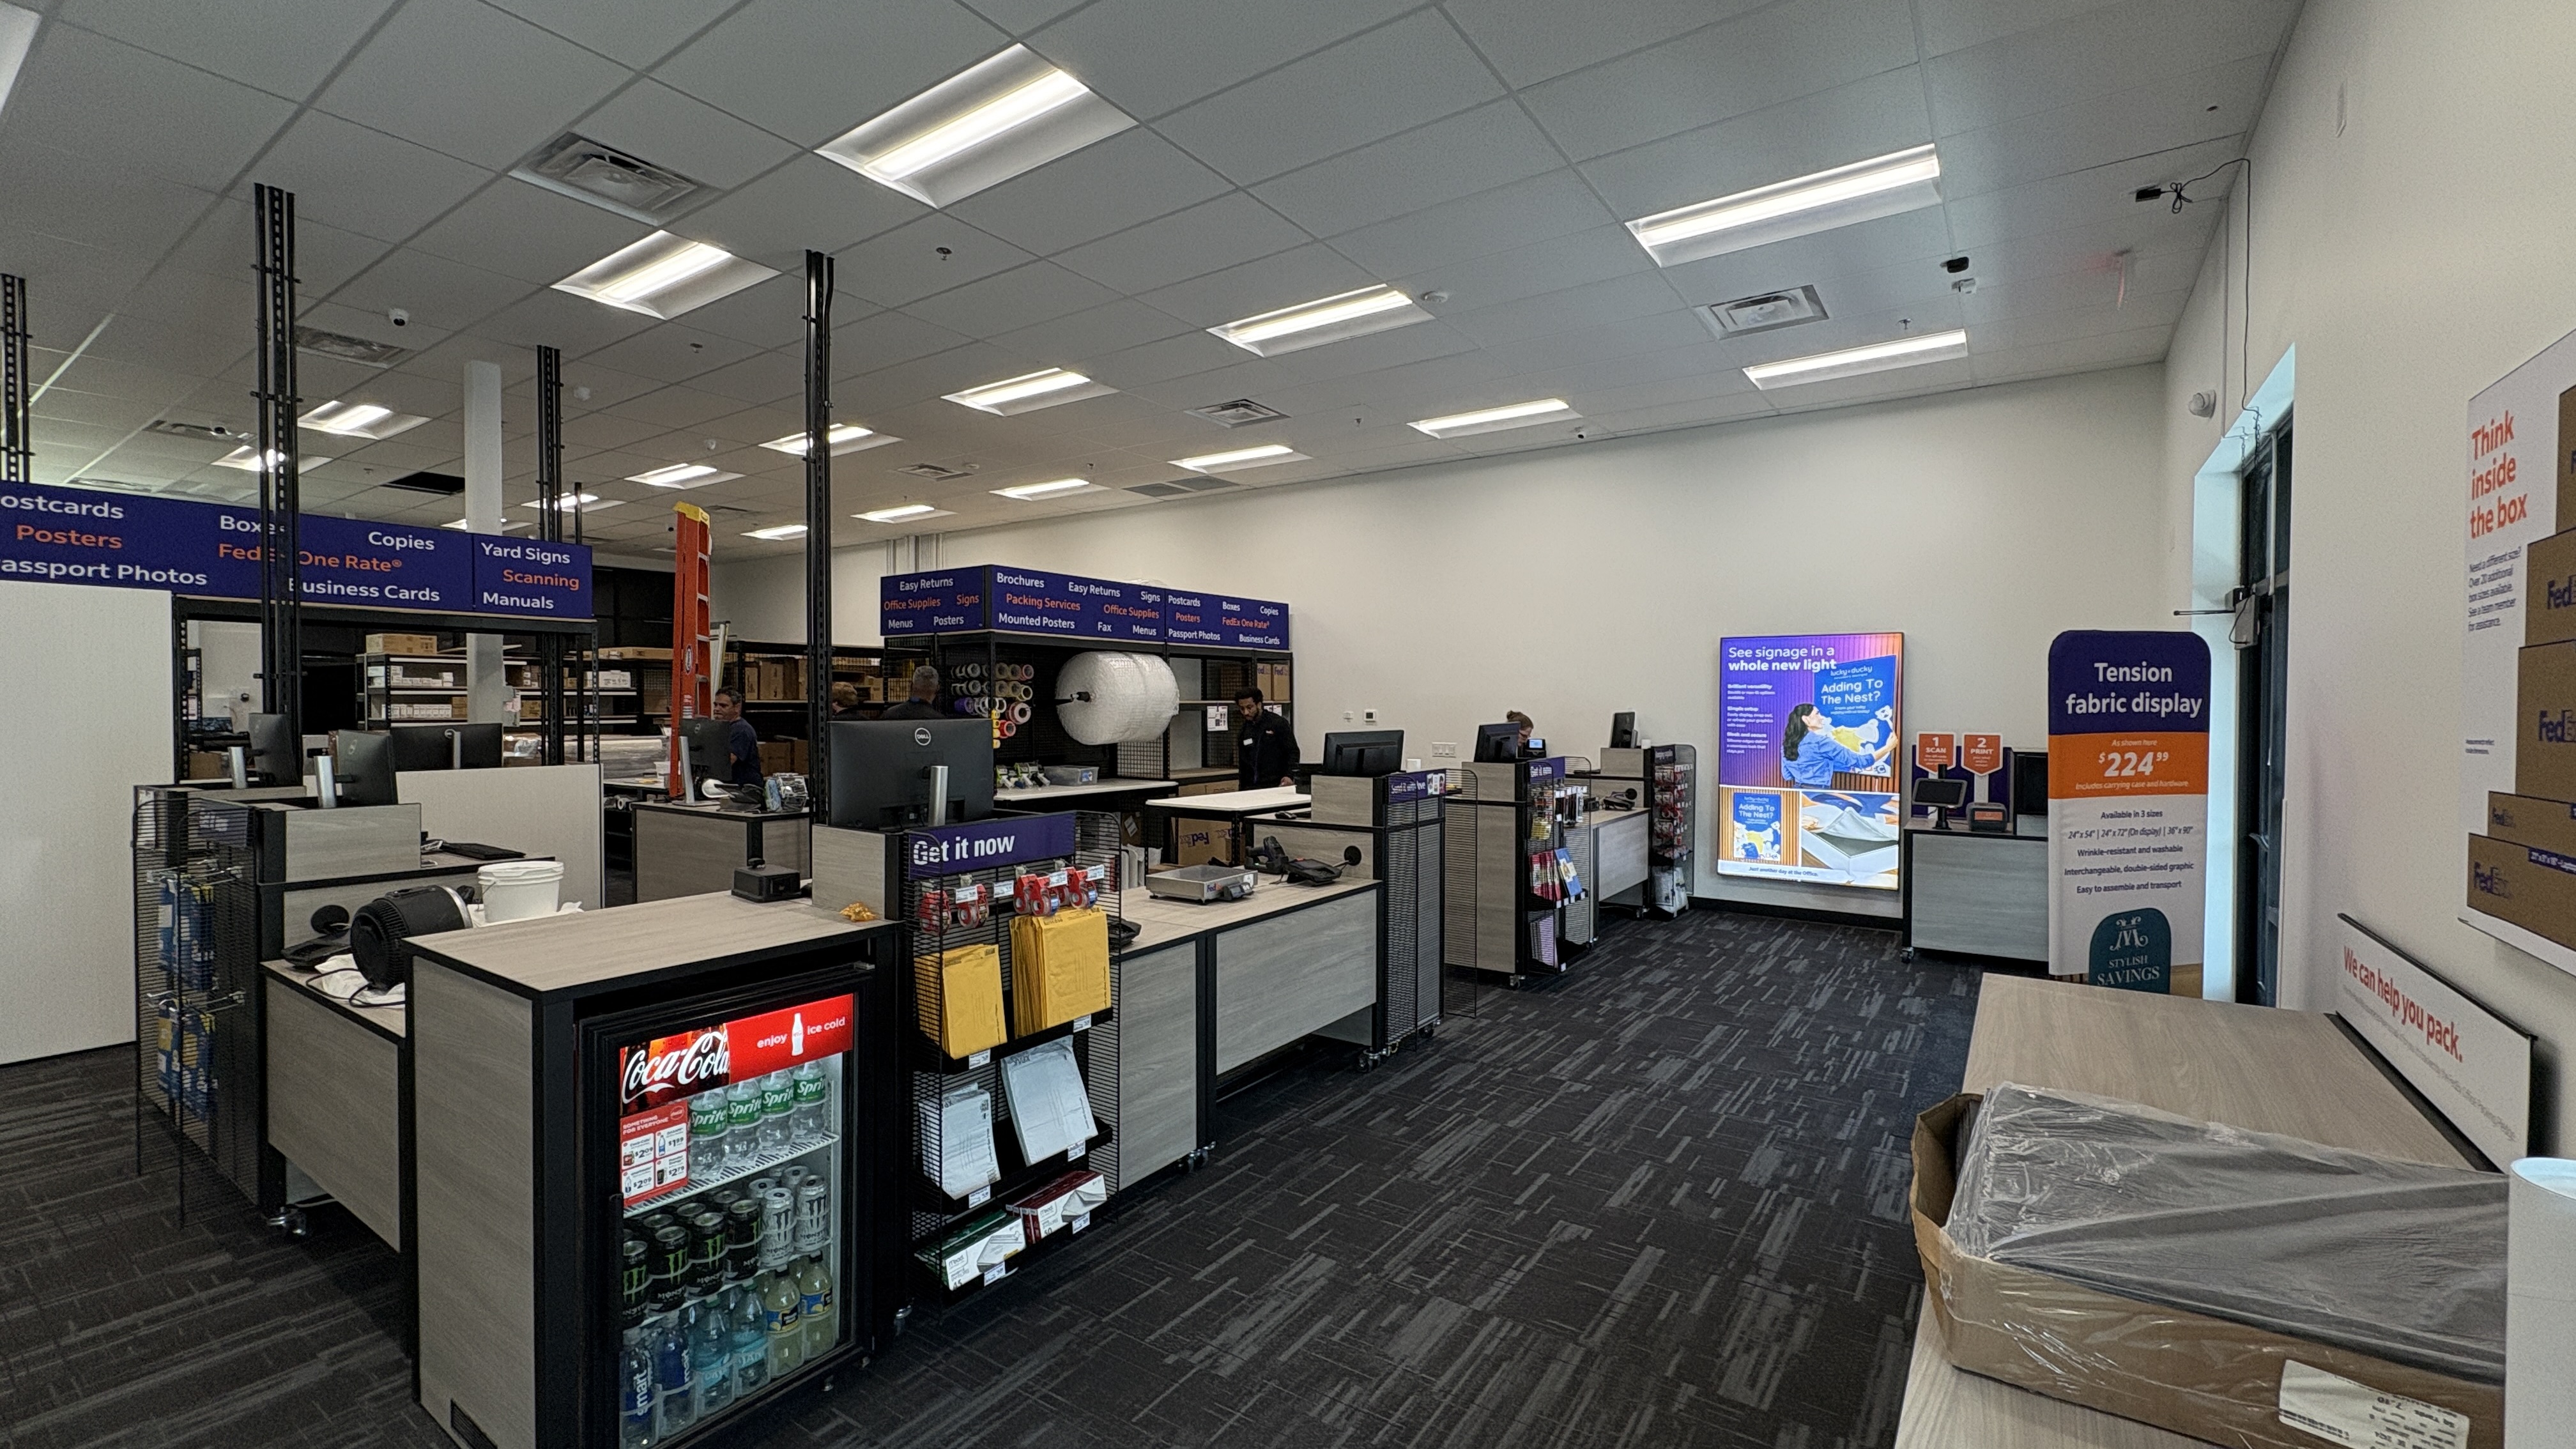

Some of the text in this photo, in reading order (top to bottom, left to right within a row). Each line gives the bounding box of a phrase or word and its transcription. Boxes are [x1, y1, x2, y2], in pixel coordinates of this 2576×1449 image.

[2472, 410, 2514, 461] Think
[2472, 452, 2516, 501] inside
[0, 494, 124, 519] ostcards
[2471, 493, 2527, 539] the box
[16, 524, 123, 549] Posters
[368, 532, 435, 551] Copies
[481, 542, 571, 565] Yard Signs
[345, 555, 402, 572] Rate®
[0, 558, 208, 585] assport Photos
[503, 569, 579, 591] Scanning
[900, 577, 954, 592] Easy Returns
[997, 572, 1045, 588] Brochures
[385, 585, 440, 602] Cards
[1068, 581, 1121, 597] Easy Returns
[482, 592, 554, 610] Manuals
[884, 597, 941, 611] Office Supplies
[956, 594, 979, 607] Signs
[1006, 593, 1080, 611] Packing Services
[1140, 592, 1161, 604] Signs
[1168, 595, 1201, 607] Postcards
[1103, 604, 1160, 620] Office Supplies
[1222, 601, 1240, 611] Boxes
[1260, 606, 1279, 616] Copies
[888, 618, 913, 629] Menus
[933, 615, 964, 626] Posters
[998, 612, 1075, 629] Mounted Posters
[1176, 612, 1200, 623] Posters
[1222, 617, 1240, 627] FedEx
[1241, 618, 1253, 627] One
[1098, 622, 1112, 632] Fax
[1132, 625, 1156, 636] Menus
[1168, 629, 1221, 641] Passport Photos
[1239, 634, 1280, 645] Business Cards
[1728, 645, 1835, 660] See signage in a
[1728, 658, 1837, 673] whole new light
[2094, 661, 2173, 682] Tension
[1821, 678, 1883, 694] Adding To
[1821, 691, 1881, 705] The Nest?
[2066, 691, 2202, 718] fabric display
[1932, 737, 1939, 747] 1
[1977, 738, 1987, 747] 2
[2103, 781, 2130, 790] carrying
[1738, 803, 1775, 813] Adding To
[1753, 811, 1774, 819] Nest?
[2101, 810, 2132, 820] Available
[1180, 832, 1210, 847] FedEx
[913, 835, 1015, 866] Get it now
[2077, 847, 2137, 857] Wrinkle-resistant
[2152, 845, 2183, 853] washable
[2064, 862, 2194, 876] Interchangeable, double-sided graphic
[2076, 885, 2093, 894] Easy
[2103, 883, 2135, 892] assemble
[2150, 880, 2182, 889] transport
[2108, 954, 2147, 969] STYLISH
[2097, 966, 2159, 986] SAVINGS
[2343, 946, 2463, 1063] We can help you pack.
[756, 1016, 846, 1050] enjoy ice cold
[622, 1031, 729, 1104] Coca-Cola
[623, 1115, 658, 1129] SOMETHING
[623, 1117, 669, 1135] FOR EVERYONE
[691, 1110, 726, 1127] Sprite
